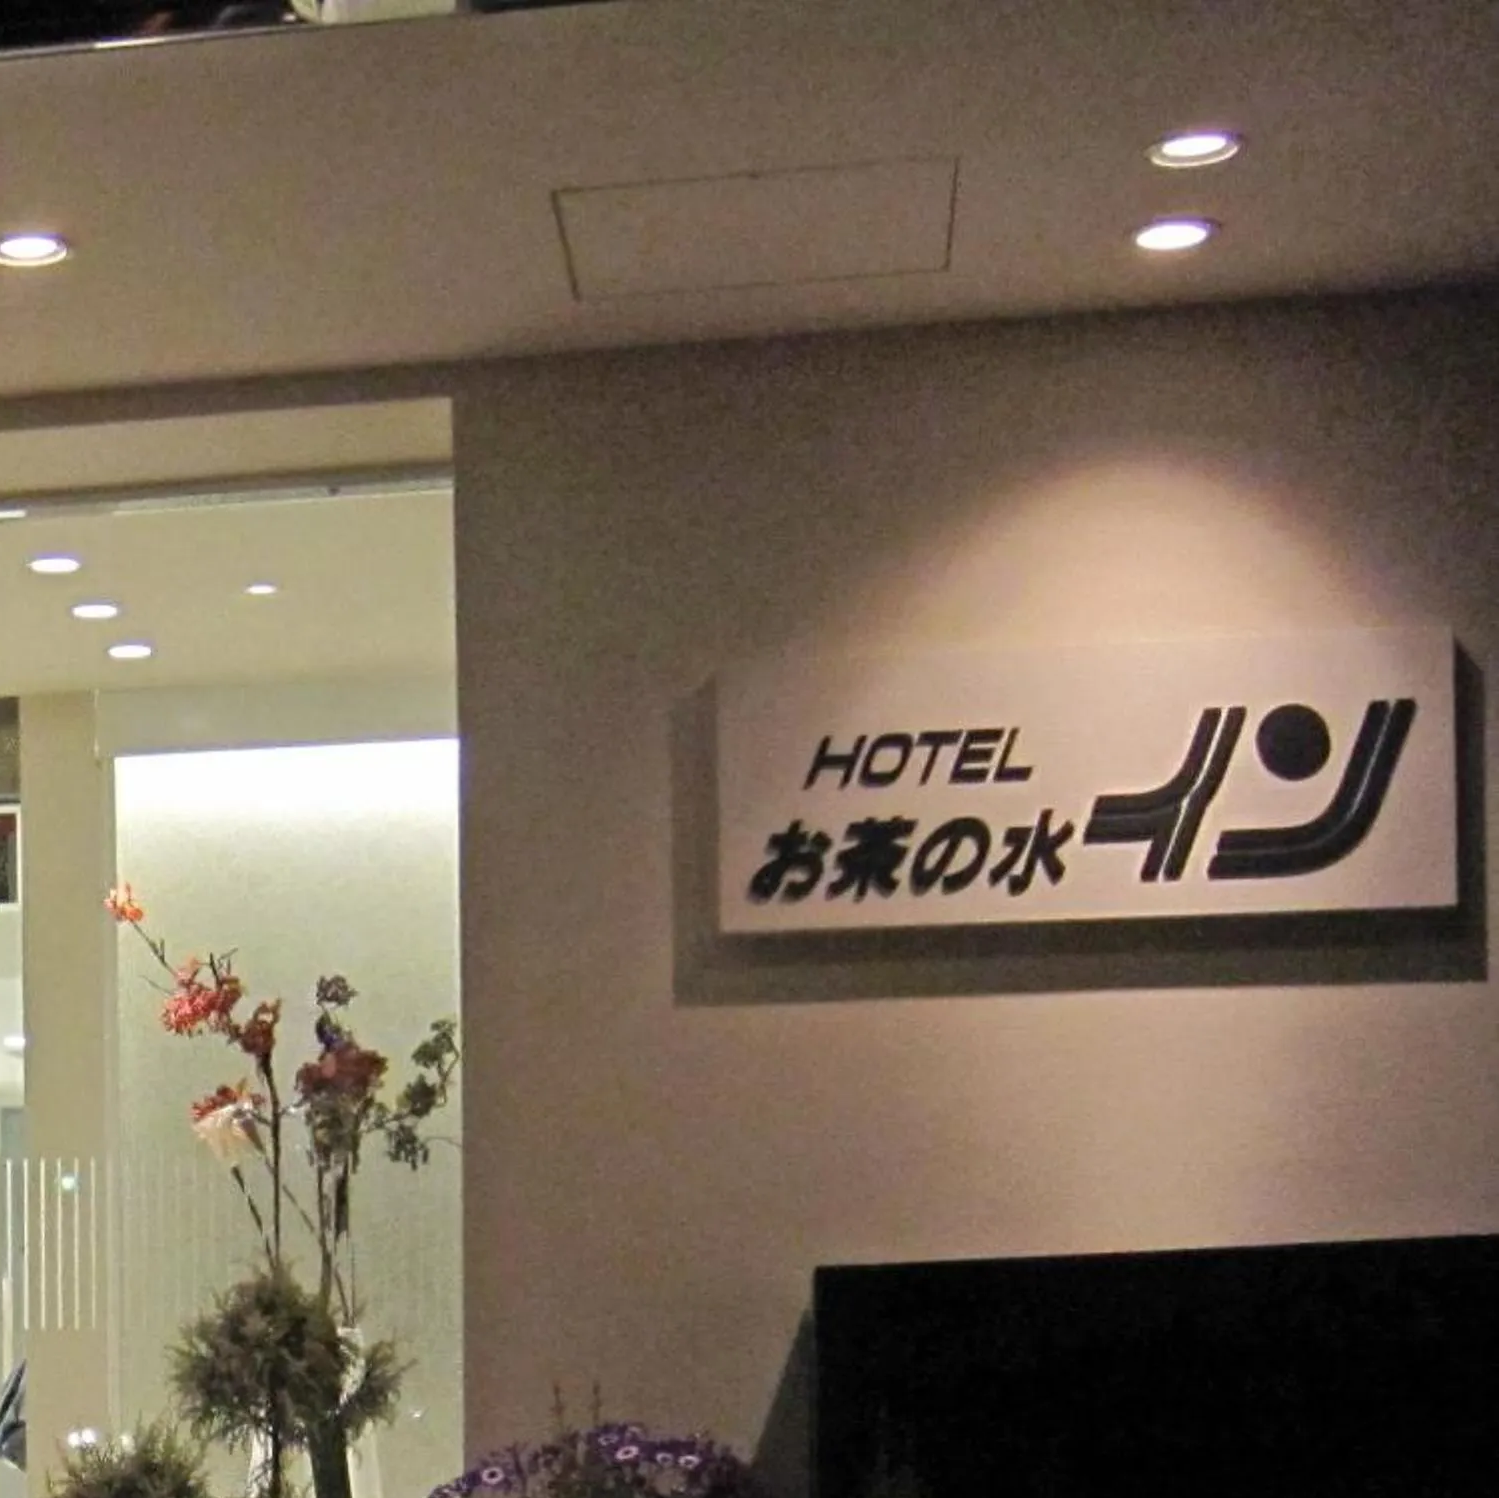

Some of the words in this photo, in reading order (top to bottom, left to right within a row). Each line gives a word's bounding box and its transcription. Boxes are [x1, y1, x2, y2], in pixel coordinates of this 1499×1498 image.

[745, 809, 1075, 906] お茶の水
[1084, 698, 1418, 883] イン
[801, 727, 1035, 791] HOTEL
